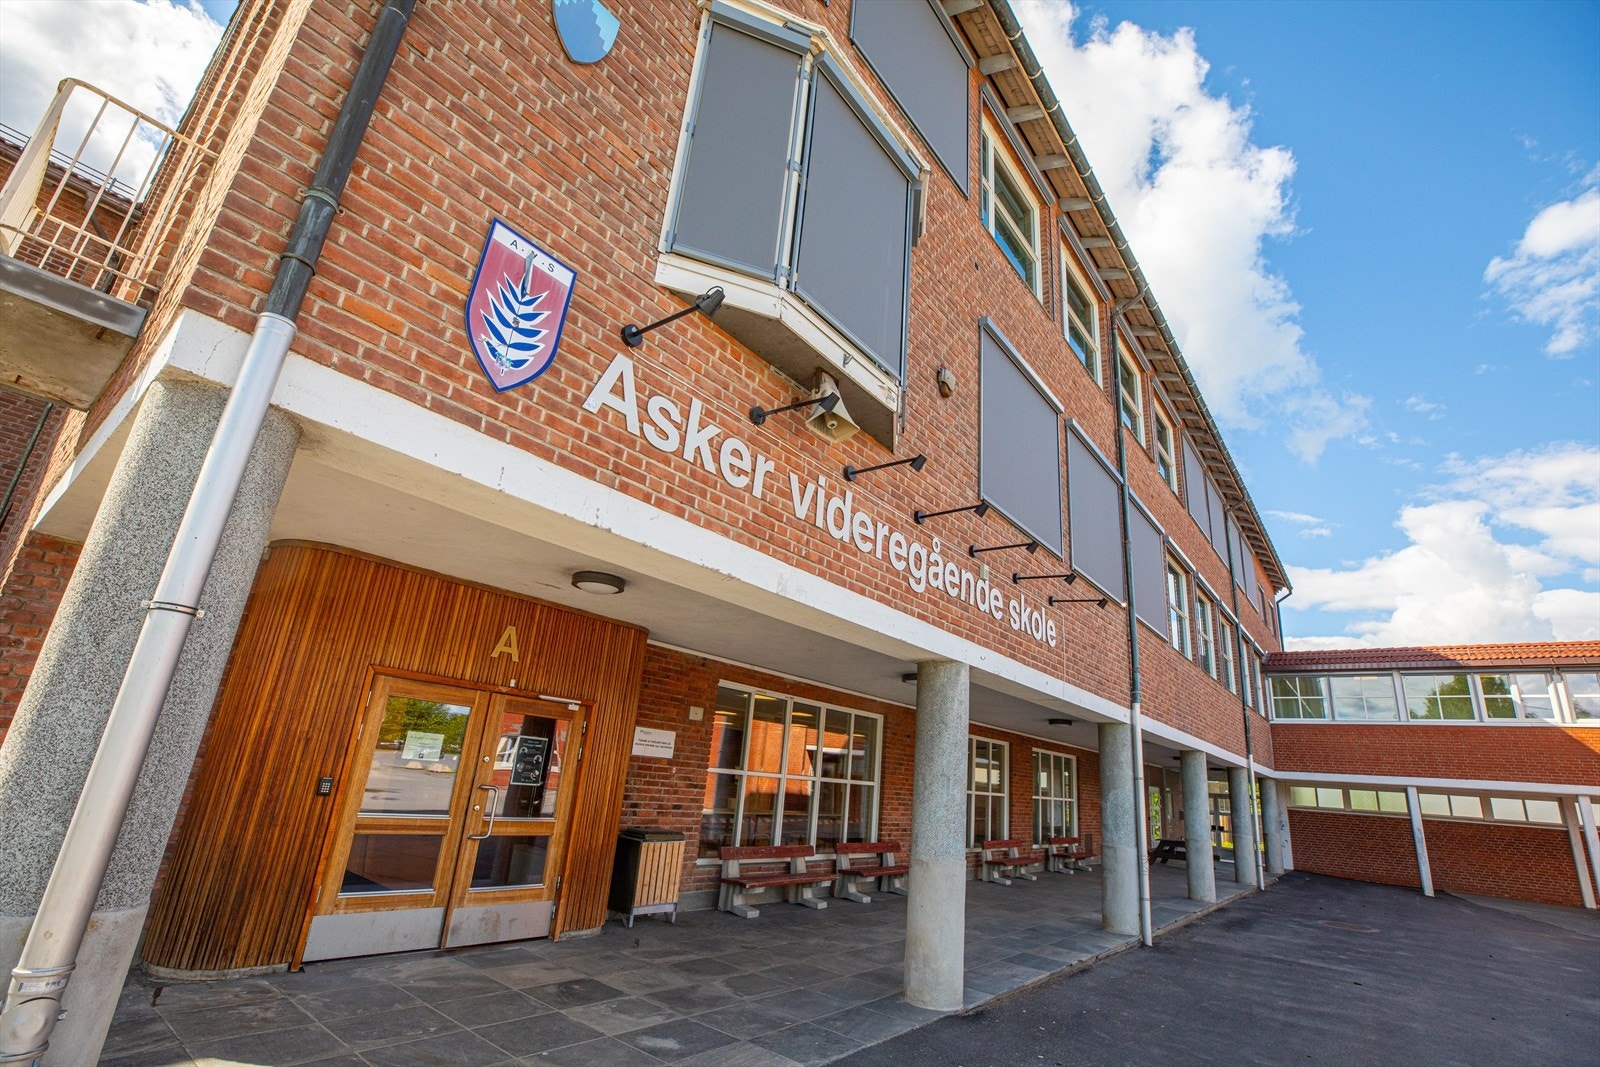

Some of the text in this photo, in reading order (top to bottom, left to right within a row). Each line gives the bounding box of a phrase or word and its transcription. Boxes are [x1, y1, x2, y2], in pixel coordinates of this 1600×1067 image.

[582, 353, 1057, 648] Asker videregående skole
[490, 625, 519, 663] A
